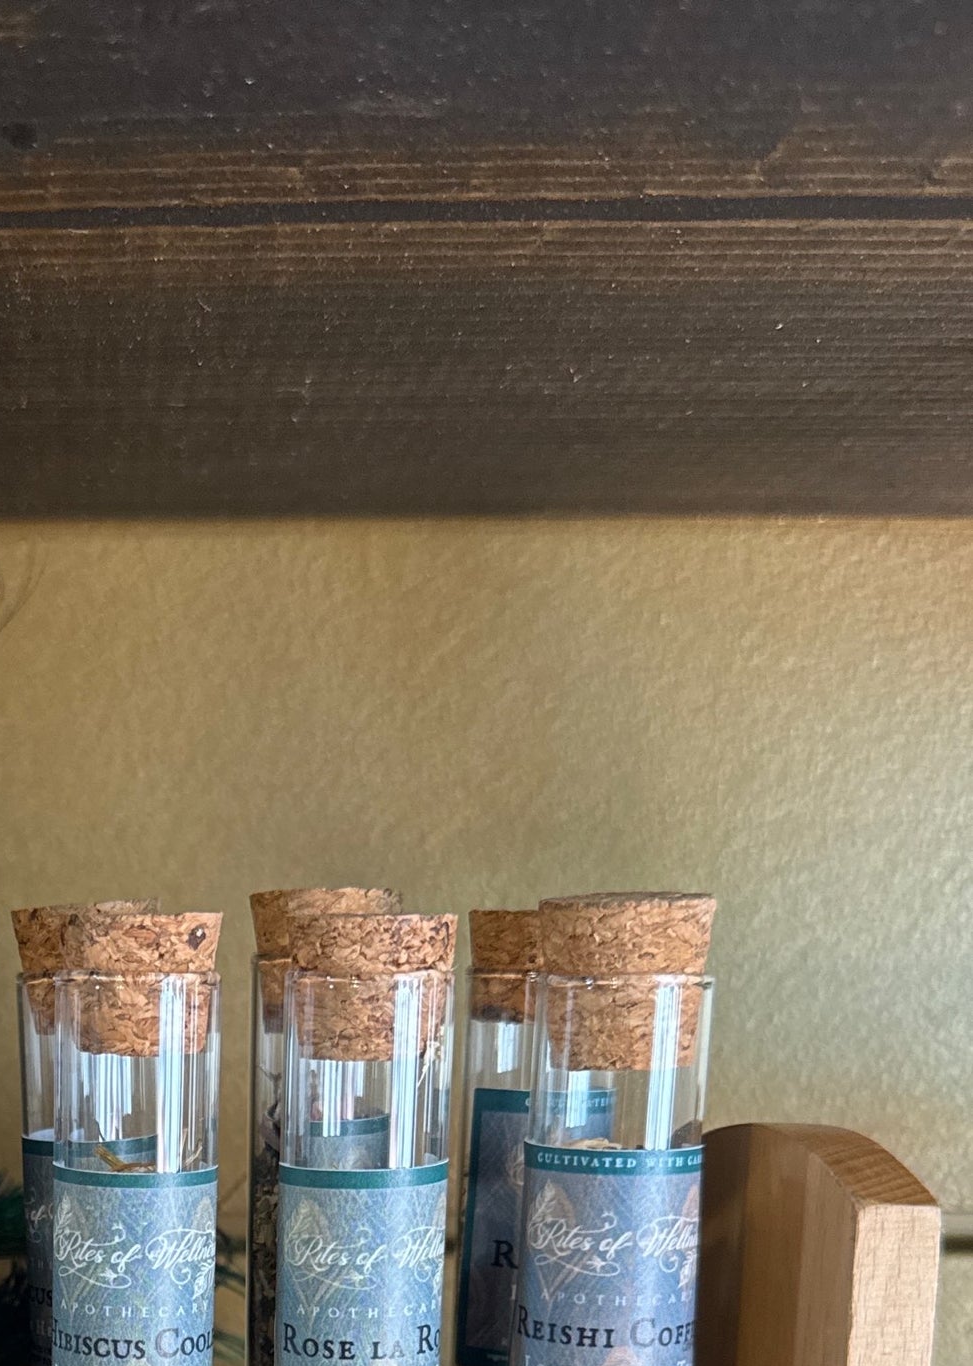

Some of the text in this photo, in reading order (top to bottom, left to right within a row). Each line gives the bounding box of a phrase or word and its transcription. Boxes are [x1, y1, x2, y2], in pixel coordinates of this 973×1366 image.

[536, 1152, 637, 1169] CULTIVATED
[645, 1156, 683, 1169] WITH
[54, 1231, 106, 1269] Rites
[110, 1243, 142, 1273] of
[289, 1233, 352, 1272] Rites
[355, 1243, 387, 1274] of
[530, 1217, 596, 1256] Rites
[598, 1231, 634, 1260] of
[60, 1299, 209, 1319] APOTHECARY
[517, 1305, 695, 1349] REISHI COFF
[154, 1328, 214, 1358] COOL
[282, 1323, 356, 1361] ROSE
